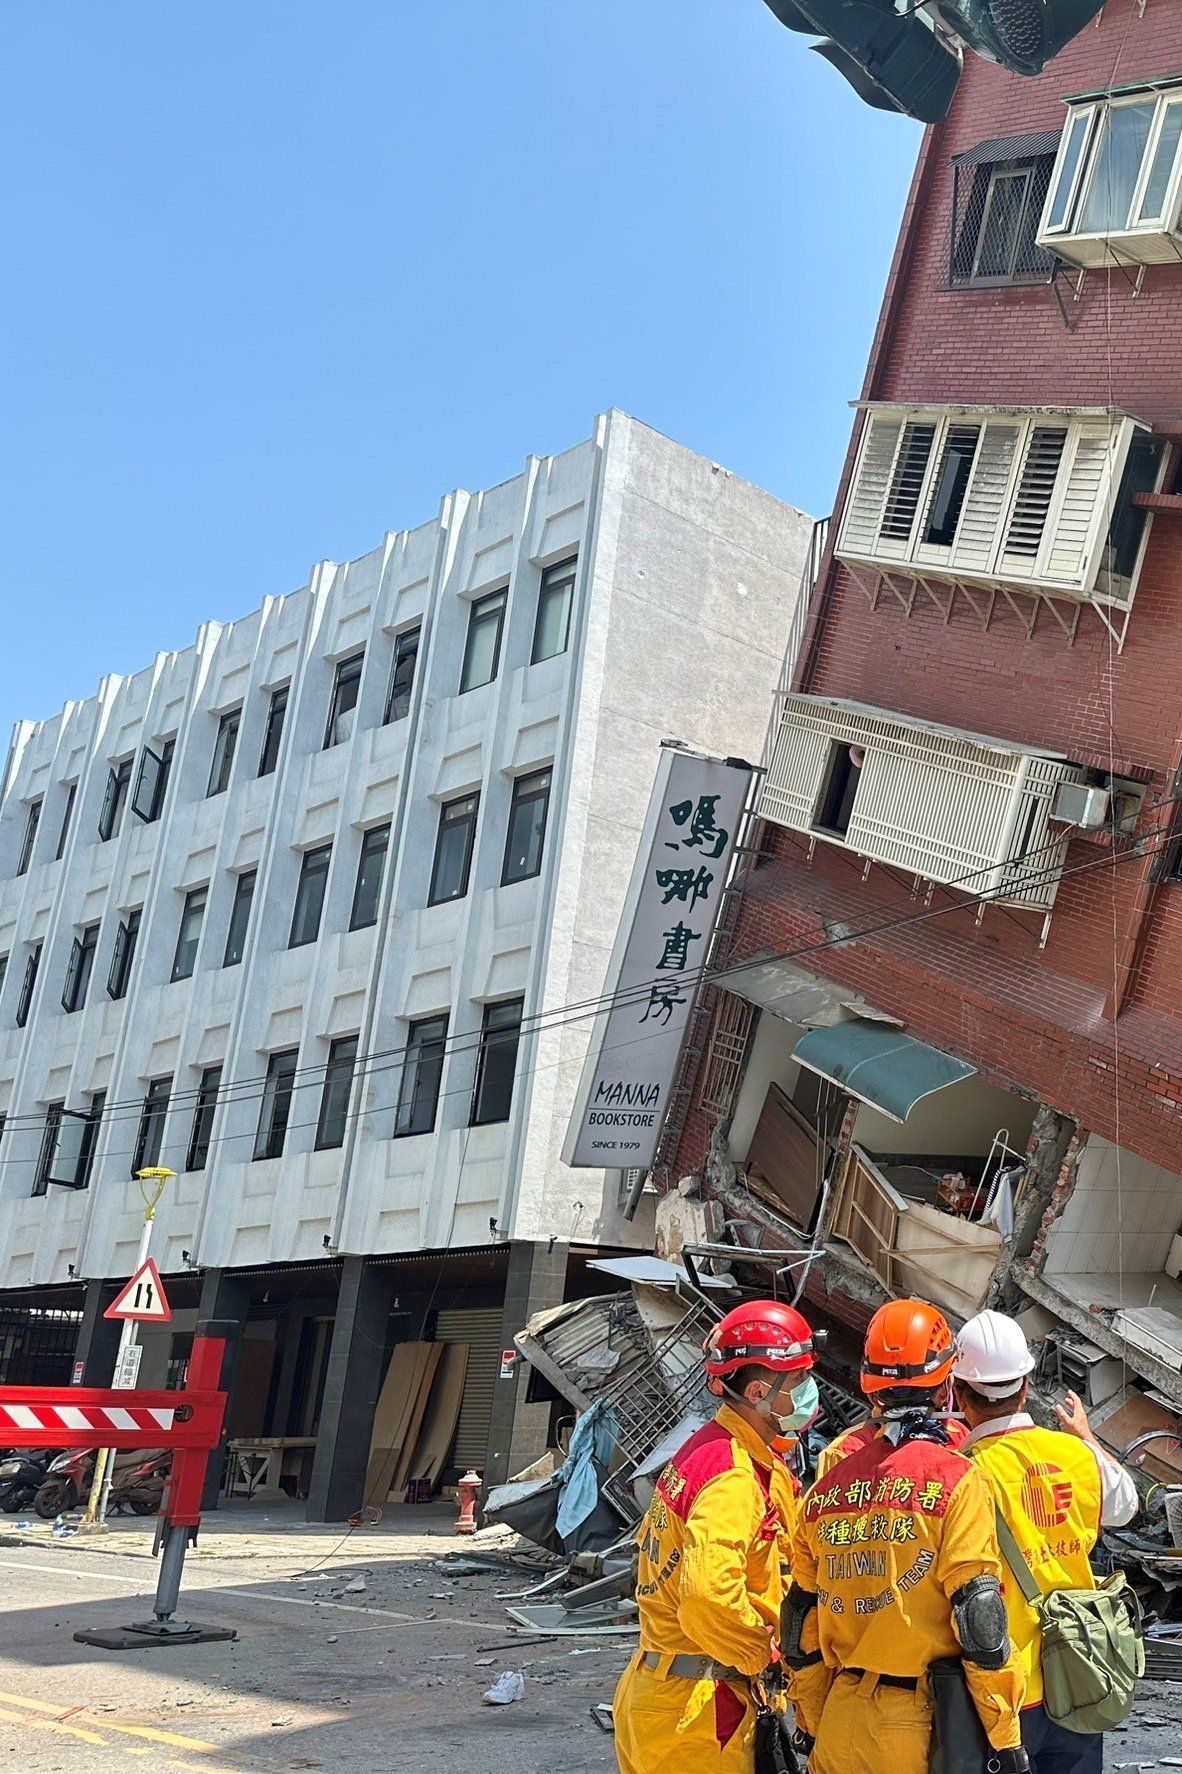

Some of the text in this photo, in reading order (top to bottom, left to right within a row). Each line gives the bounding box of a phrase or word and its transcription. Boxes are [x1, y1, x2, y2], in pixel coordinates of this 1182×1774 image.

[638, 795, 728, 1026] 嗎哪書房
[594, 1080, 660, 1108] MANNA
[588, 1112, 655, 1127] BOOKSTORE
[591, 1140, 641, 1150] SINCE 1979
[806, 1477, 944, 1516] 內政部消防署
[831, 1596, 845, 1614] &
[897, 1548, 935, 1593] TEAM
